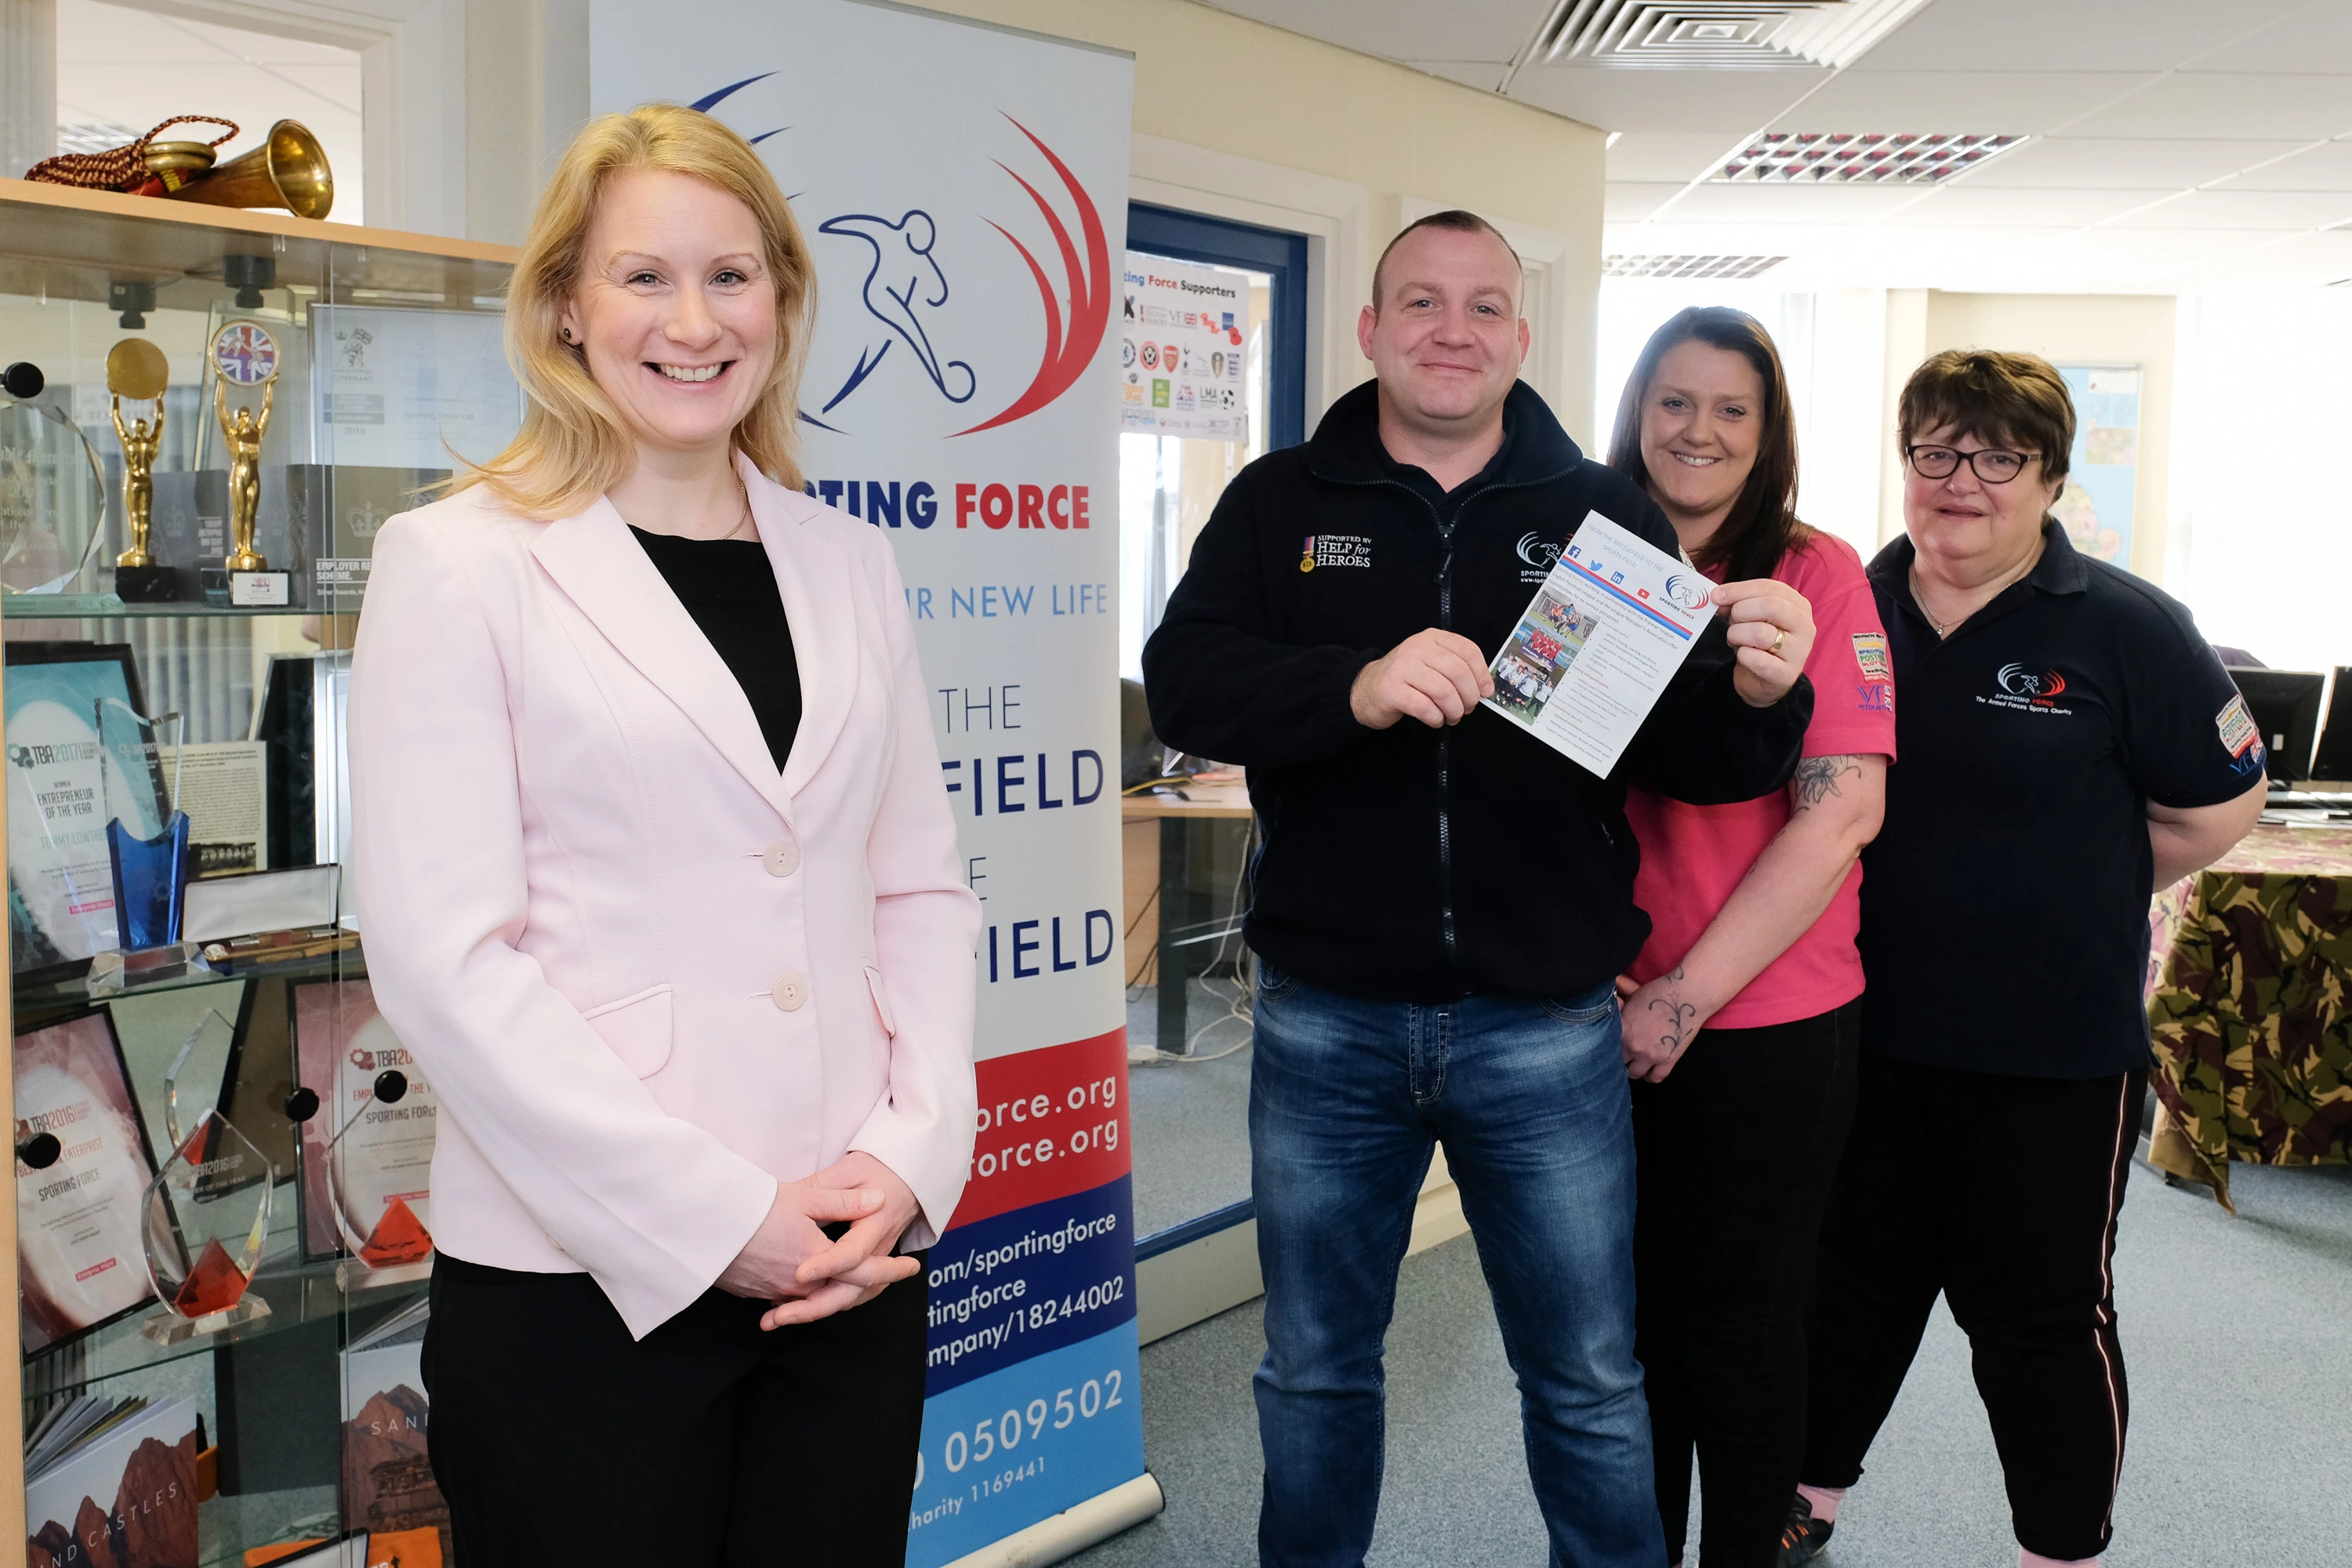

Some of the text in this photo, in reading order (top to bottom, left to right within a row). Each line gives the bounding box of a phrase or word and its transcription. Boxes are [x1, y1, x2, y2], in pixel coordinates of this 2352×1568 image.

[1149, 275, 1178, 289] Force
[1181, 280, 1236, 298] Supporters
[955, 483, 1091, 530] FORCE
[1316, 541, 1371, 557] HELP for
[1316, 554, 1371, 568] HEROES
[1586, 523, 1603, 536] FROM
[1602, 532, 1613, 542] THE
[1612, 539, 1646, 561] BATTLEFIELD
[1653, 563, 1664, 572] THE
[1602, 544, 1637, 568] SPORTS FIELD
[316, 561, 360, 572] EMPLOYER
[951, 585, 1035, 619] NEW
[1052, 583, 1107, 615] LIFE
[1658, 596, 1680, 612] SPORTING
[1680, 609, 1694, 620] FORCE
[938, 684, 1021, 733] THE
[1987, 698, 2007, 707] Armed
[2007, 701, 2027, 710] Forces
[2028, 704, 2049, 713] Sports
[2050, 707, 2072, 716] Charity
[1994, 693, 2055, 707] SPORTING FORCE
[37, 788, 95, 806] ENTREPRENEUR
[45, 802, 93, 819] OF THE YEAR
[988, 909, 1114, 983] IELD
[365, 1108, 409, 1125] SPORTING
[977, 1076, 1116, 1132] orce.org
[63, 1136, 104, 1162] ENTERPRISE
[196, 1156, 229, 1177] BA2016
[38, 1167, 101, 1202] SPORTING FORCE
[928, 1214, 1116, 1288] om/sportingforce
[927, 1279, 1027, 1328] tingforce
[926, 1275, 1124, 1368] mpany/18244002
[945, 1370, 1123, 1473] 0509502
[908, 1496, 964, 1531] harity
[971, 1456, 1045, 1502] 1169441
[88, 1482, 176, 1548] CASTLES
